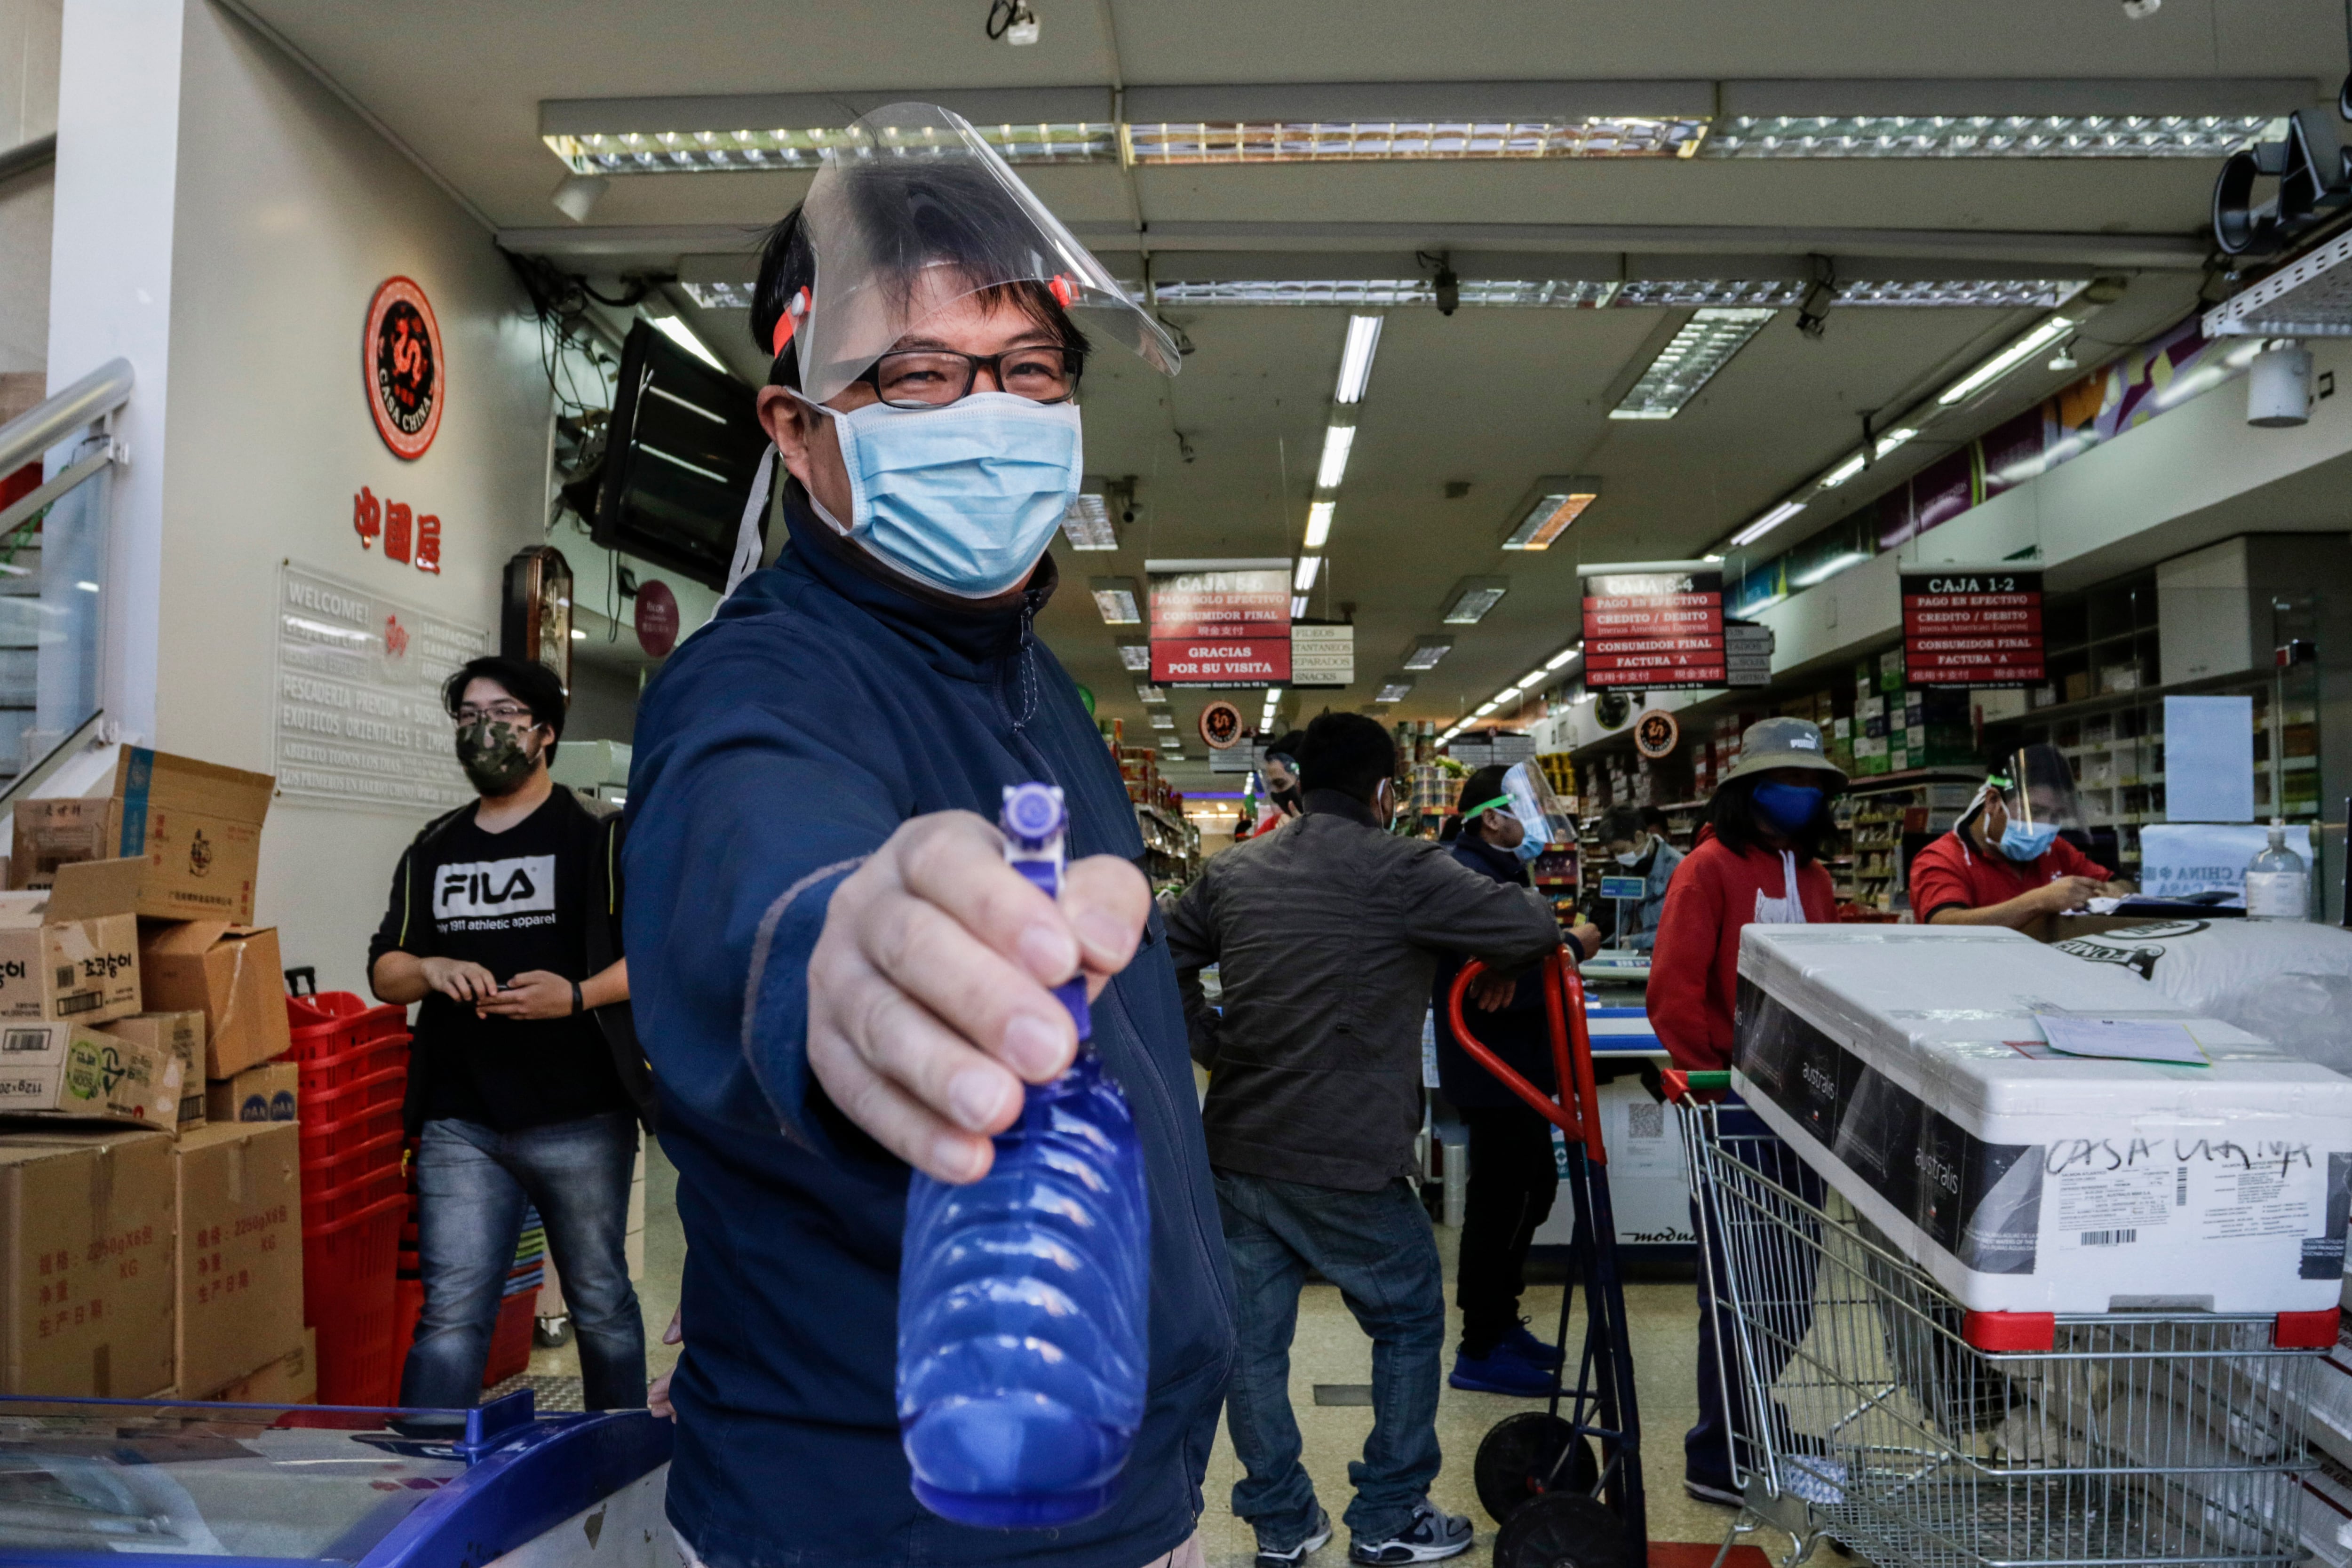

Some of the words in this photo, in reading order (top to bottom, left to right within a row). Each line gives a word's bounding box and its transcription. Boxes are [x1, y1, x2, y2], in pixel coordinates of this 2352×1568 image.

[379, 368, 400, 423] CASA
[402, 397, 431, 432] CHINA
[1176, 577, 1228, 591] CAJA
[1607, 579, 1658, 595] CAJA
[1666, 578, 1694, 593] 3-4
[1930, 578, 1980, 593] CAJA
[1988, 578, 2014, 591] 1-2
[289, 581, 369, 624] WELCOME!
[1158, 596, 1189, 605] PAGO
[1192, 595, 1223, 605] SOLO
[1226, 595, 1285, 604] EFECTIVO
[1597, 598, 1628, 608] PAGO
[1631, 598, 1647, 607] EN
[1651, 596, 1708, 606] EFECTIVO
[1918, 597, 1948, 606] PAGO
[1971, 595, 2028, 605] EFECTIVO
[1163, 611, 1240, 621] CONSUMIDOR
[1244, 611, 1278, 620] FINAL
[1597, 613, 1650, 624] CREDITO
[1664, 611, 1708, 622] DEBITO
[1918, 613, 1971, 622] CREDITO
[1983, 611, 2028, 621] DEBITO
[1597, 640, 1675, 652] CONSUMIDOR
[1678, 639, 1712, 649] FINAL
[1917, 639, 1995, 650] CONSUMIDOR
[1998, 638, 2032, 648] FINAL
[1189, 647, 1252, 658] GRACIAS
[1938, 655, 1992, 665] FACTURA
[1168, 663, 1198, 674] POR
[1202, 663, 1221, 673] SU
[1225, 662, 1272, 673] VISITA
[1294, 657, 1350, 666] EPARADOS
[1617, 656, 1670, 667] FACTURA
[283, 674, 351, 708] PESCADERIA
[356, 691, 400, 716] PREMIUM
[414, 703, 441, 727] SUSHI
[283, 706, 340, 735] EXOTICOS
[346, 717, 409, 746] ORIENTALES
[415, 729, 422, 748] E
[427, 732, 457, 753] IMPOR
[283, 742, 326, 762] ABIERTO
[329, 749, 359, 768] TODOS
[361, 754, 378, 771] LOS
[380, 756, 400, 772] DIAS
[281, 767, 300, 786] LOS
[442, 868, 535, 907] FILA
[450, 920, 466, 932] 1911
[468, 916, 510, 931] athletic
[512, 913, 556, 928] apparel
[1803, 1062, 1835, 1100] australis
[2046, 1138, 2165, 1175] CASA
[1915, 1147, 1958, 1194] australis
[261, 1234, 276, 1252] KG
[119, 1258, 138, 1279] KG
